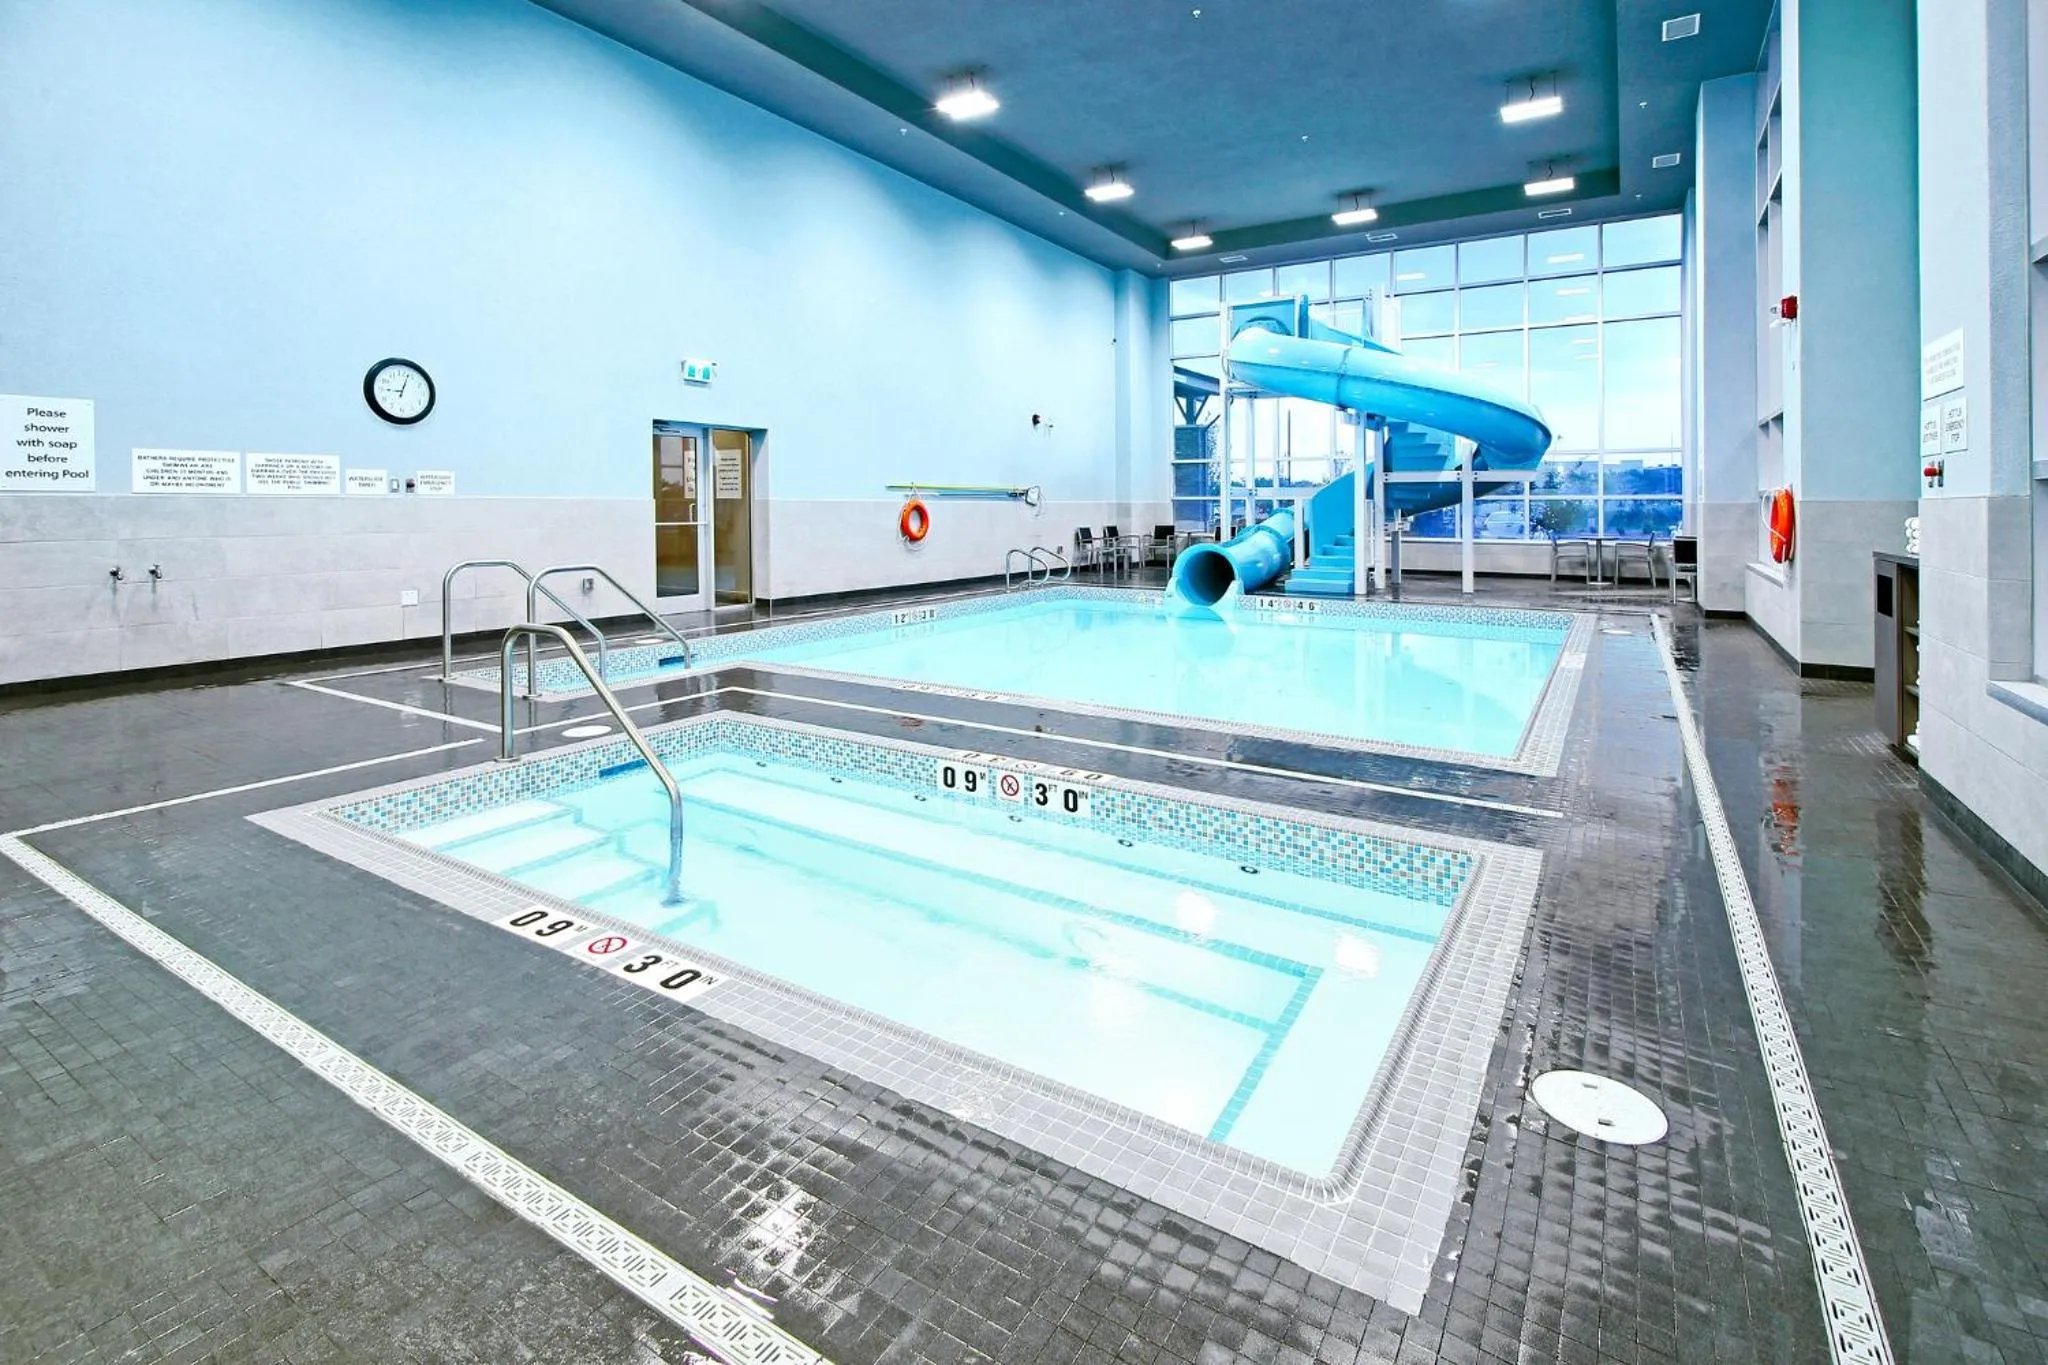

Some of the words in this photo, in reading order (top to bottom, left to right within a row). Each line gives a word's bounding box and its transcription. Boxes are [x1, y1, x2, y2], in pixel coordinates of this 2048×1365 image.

[27, 407, 67, 418] Please
[24, 422, 69, 433] shower
[16, 438, 45, 448] with
[48, 440, 78, 450] soap
[27, 453, 69, 464] before
[5, 469, 59, 480] entering
[62, 469, 90, 479] Pool
